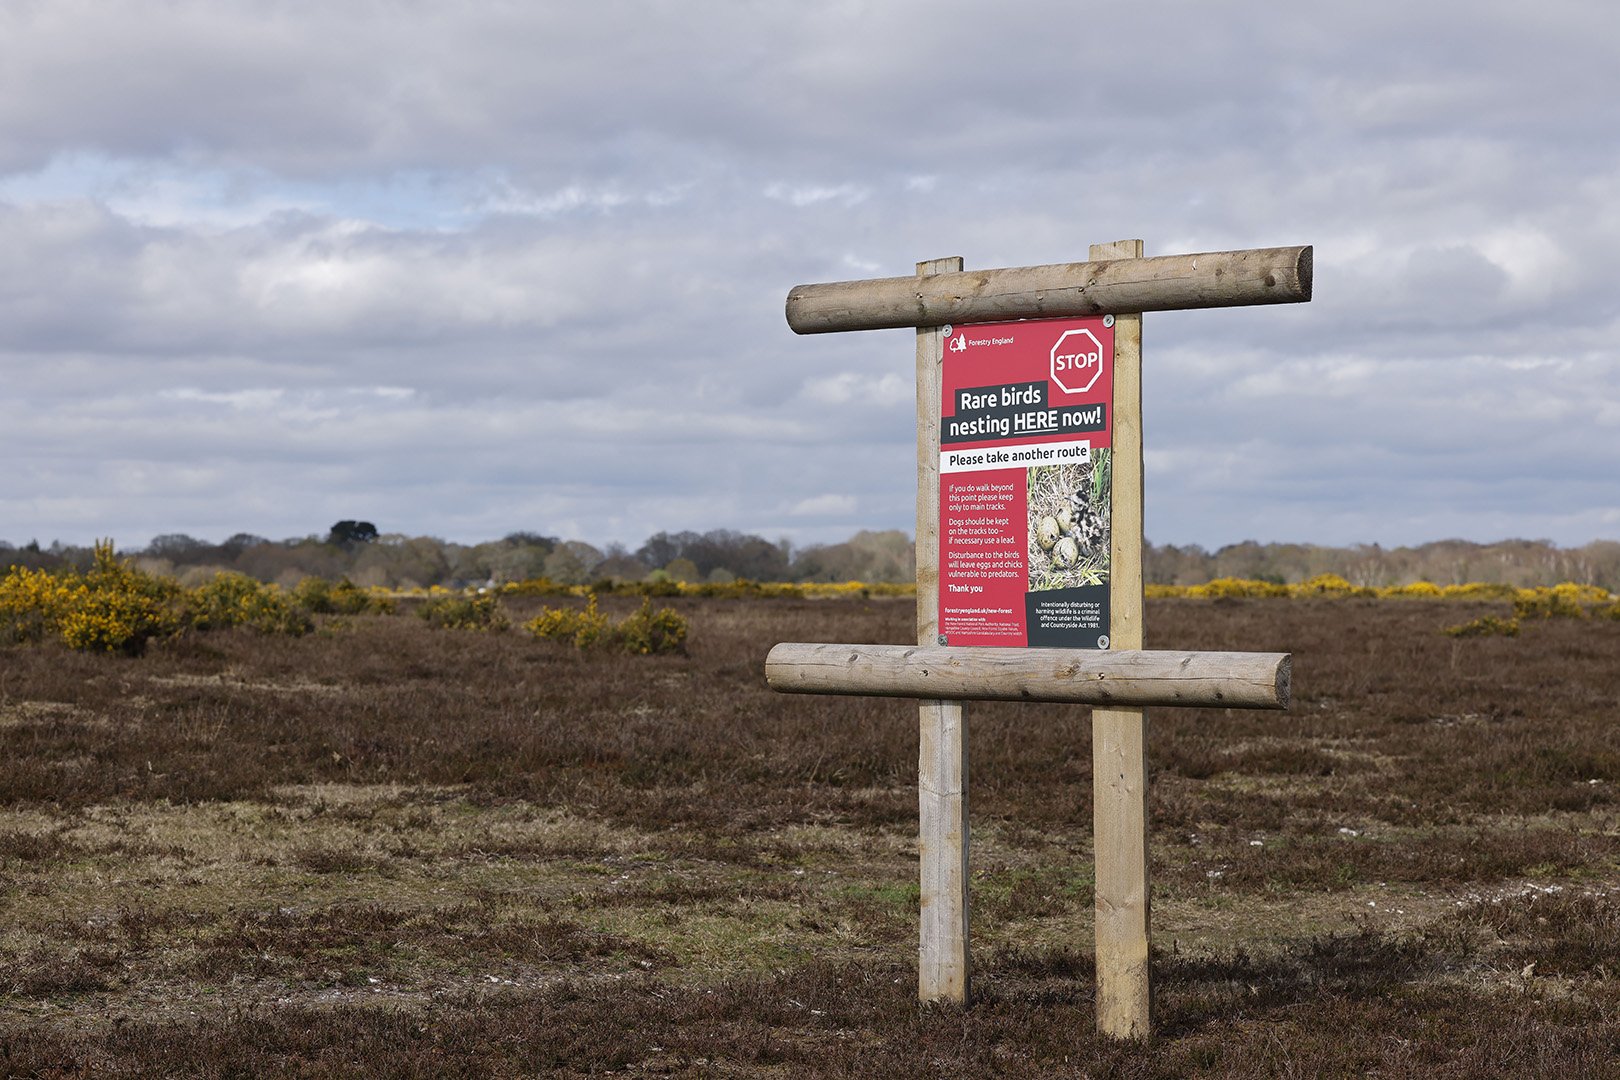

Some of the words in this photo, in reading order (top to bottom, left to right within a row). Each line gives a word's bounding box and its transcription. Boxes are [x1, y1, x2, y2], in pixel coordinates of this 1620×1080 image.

[968, 338, 991, 346] Forestry
[1056, 353, 1098, 370] STOP
[961, 393, 997, 410] Rare
[1002, 385, 1041, 406] birds
[950, 416, 1009, 436] nesting
[1014, 410, 1058, 430] HERE
[1063, 407, 1101, 426] now!
[950, 455, 983, 466] Please
[987, 452, 1009, 463] take
[1012, 448, 1055, 461] another
[1057, 446, 1087, 457] route
[991, 484, 1013, 492] beyond
[961, 494, 976, 502] point
[978, 493, 997, 502] please
[977, 562, 991, 570] eggs
[970, 585, 983, 593] you
